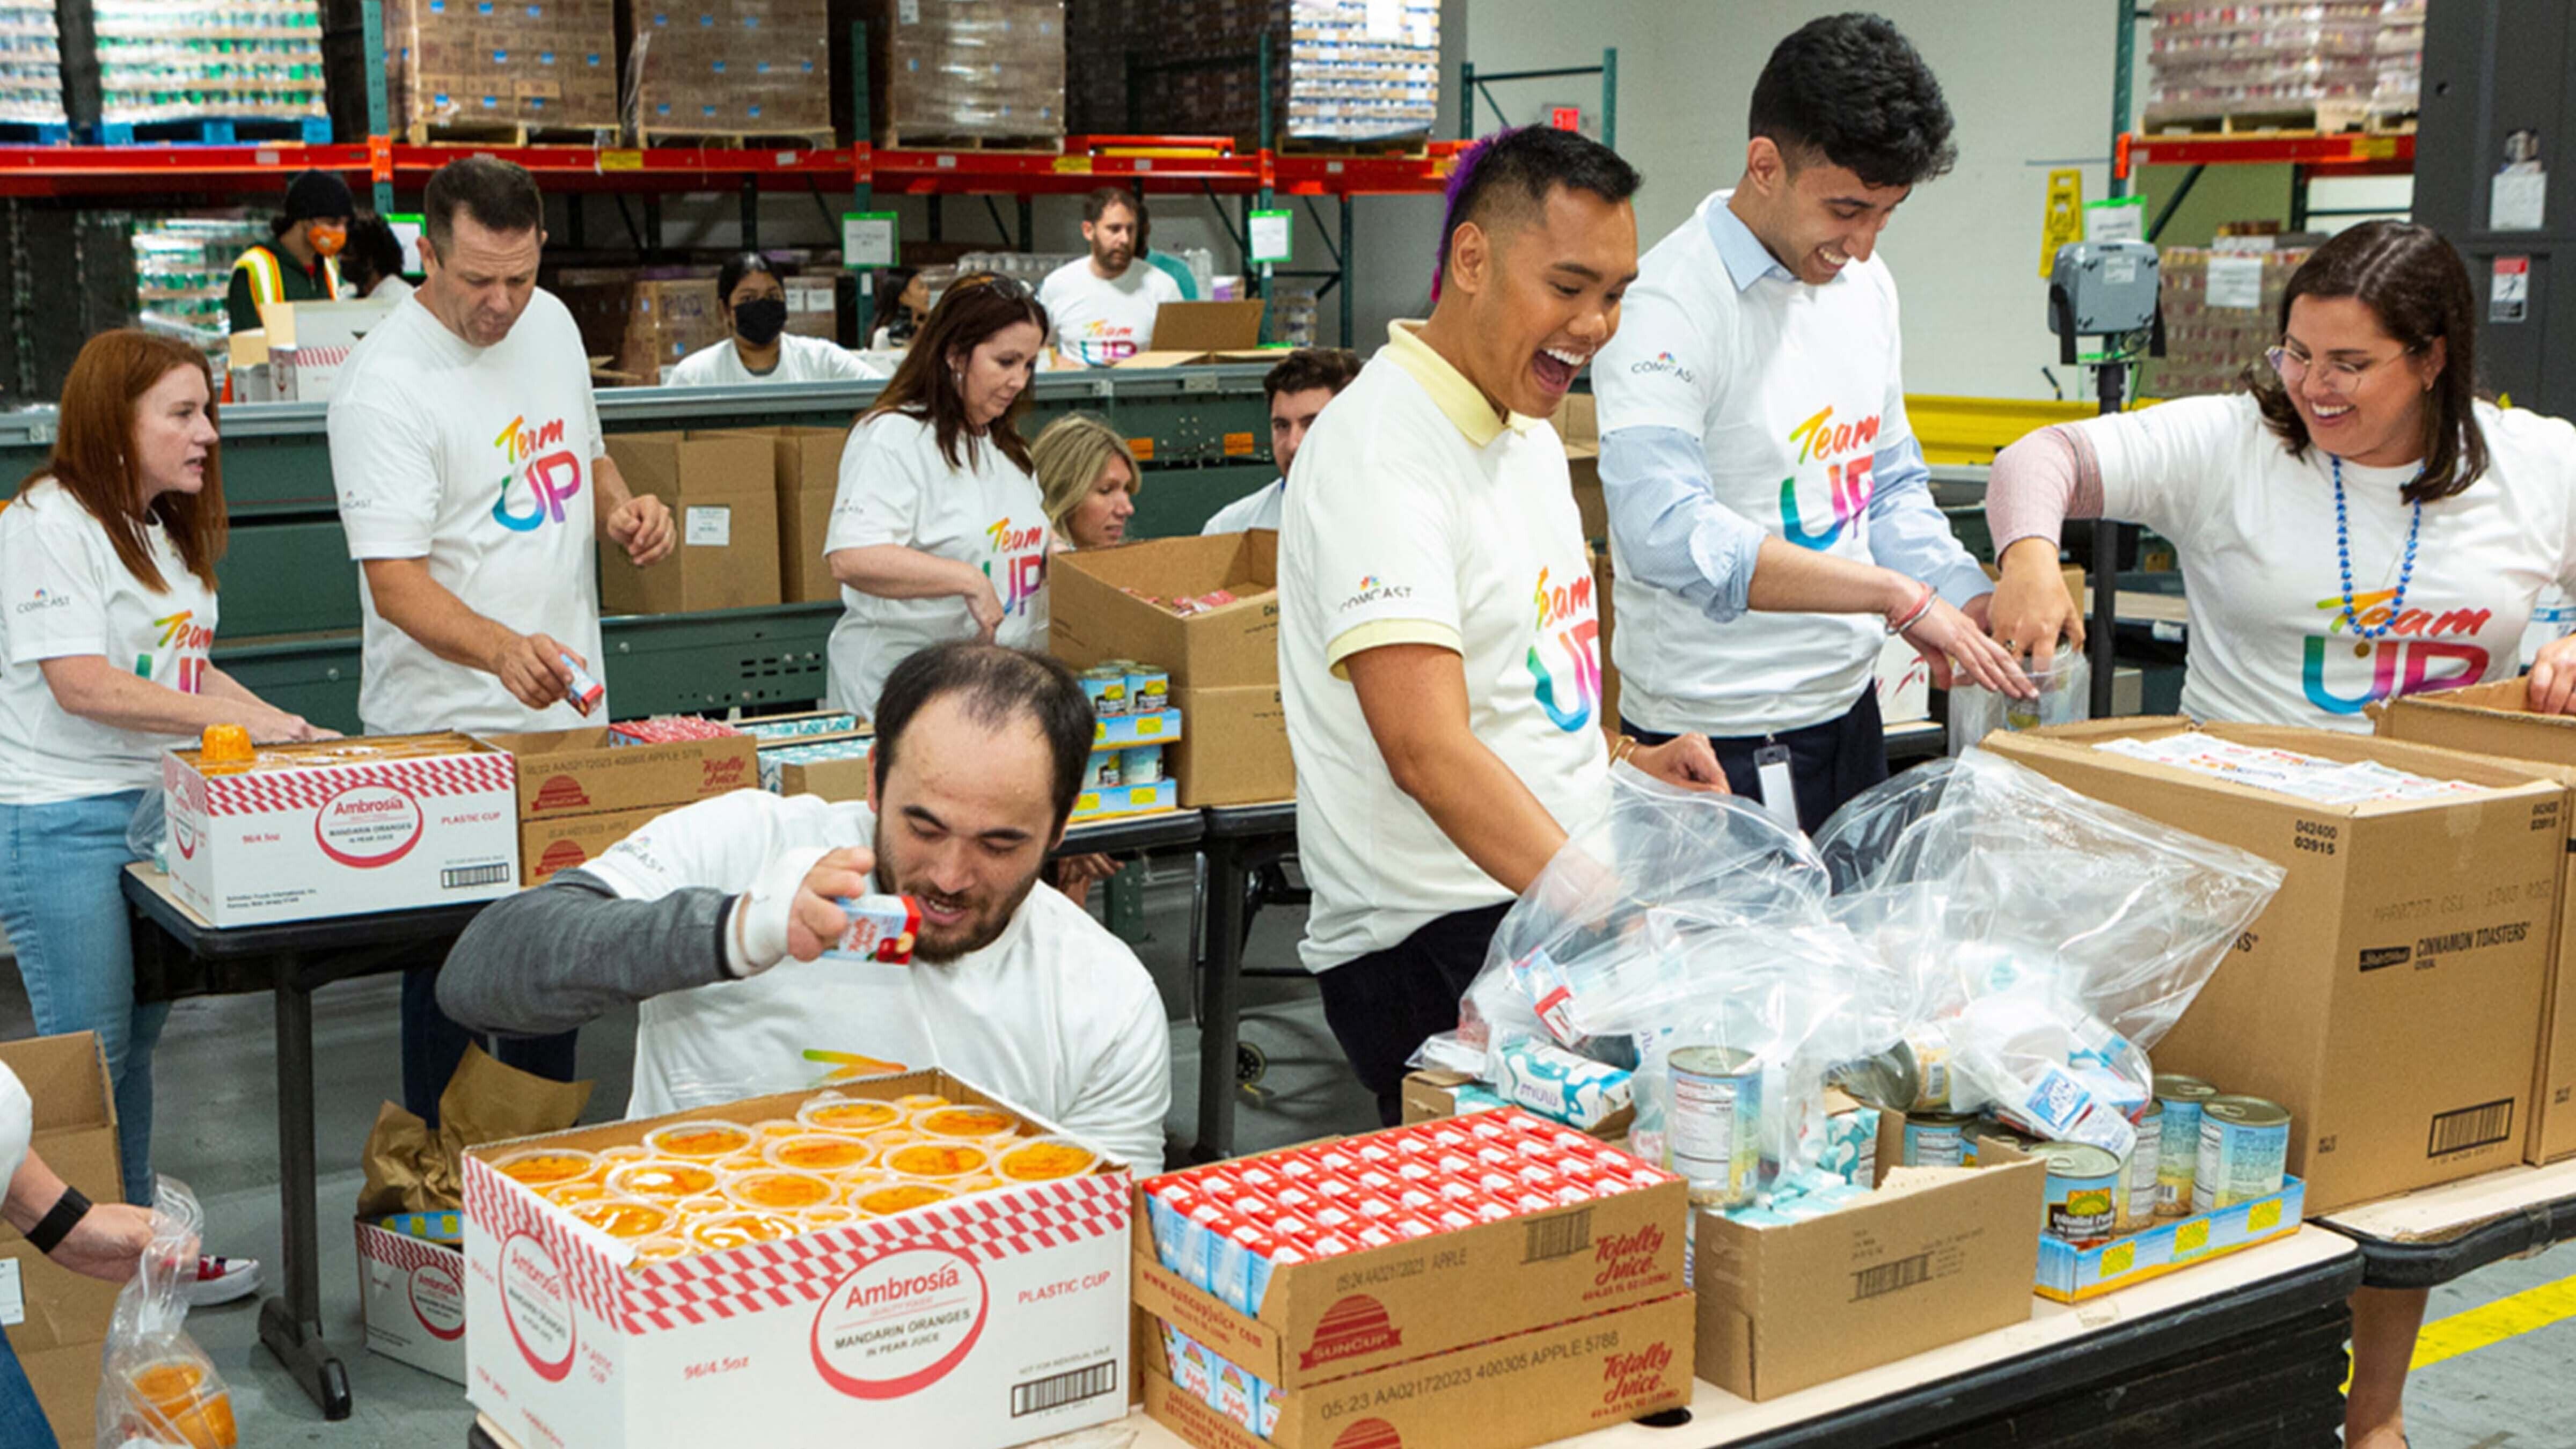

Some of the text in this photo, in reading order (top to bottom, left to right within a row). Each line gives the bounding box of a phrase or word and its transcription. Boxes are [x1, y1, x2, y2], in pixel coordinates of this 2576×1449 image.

[1789, 405, 1880, 465] Team
[491, 450, 581, 532] UP
[986, 517, 1043, 553] Team
[2316, 586, 2492, 637] Team
[2302, 634, 2490, 715] UP
[441, 811, 501, 825] PLASTIC CUP
[2295, 819, 2338, 839] 042400
[2294, 836, 2336, 855] 03915
[2417, 930, 2472, 957] CINNAMON
[1431, 1247, 1467, 1270] APPLE
[1595, 1222, 1666, 1263] Totally
[1018, 1270, 1111, 1305] PLASTIC CUP
[1594, 1256, 1652, 1286] Juice
[834, 1308, 970, 1350] MANDARIN ORANGES
[865, 1332, 940, 1358] IN PEAR JUICE
[1313, 1333, 1389, 1360] SUNCUP
[1604, 1341, 1673, 1381] Totally
[1321, 1391, 1370, 1421] 05:23
[1374, 1369, 1472, 1406] AA02172023
[1530, 1342, 1583, 1367] APPLE
[1604, 1374, 1660, 1404] Juice
